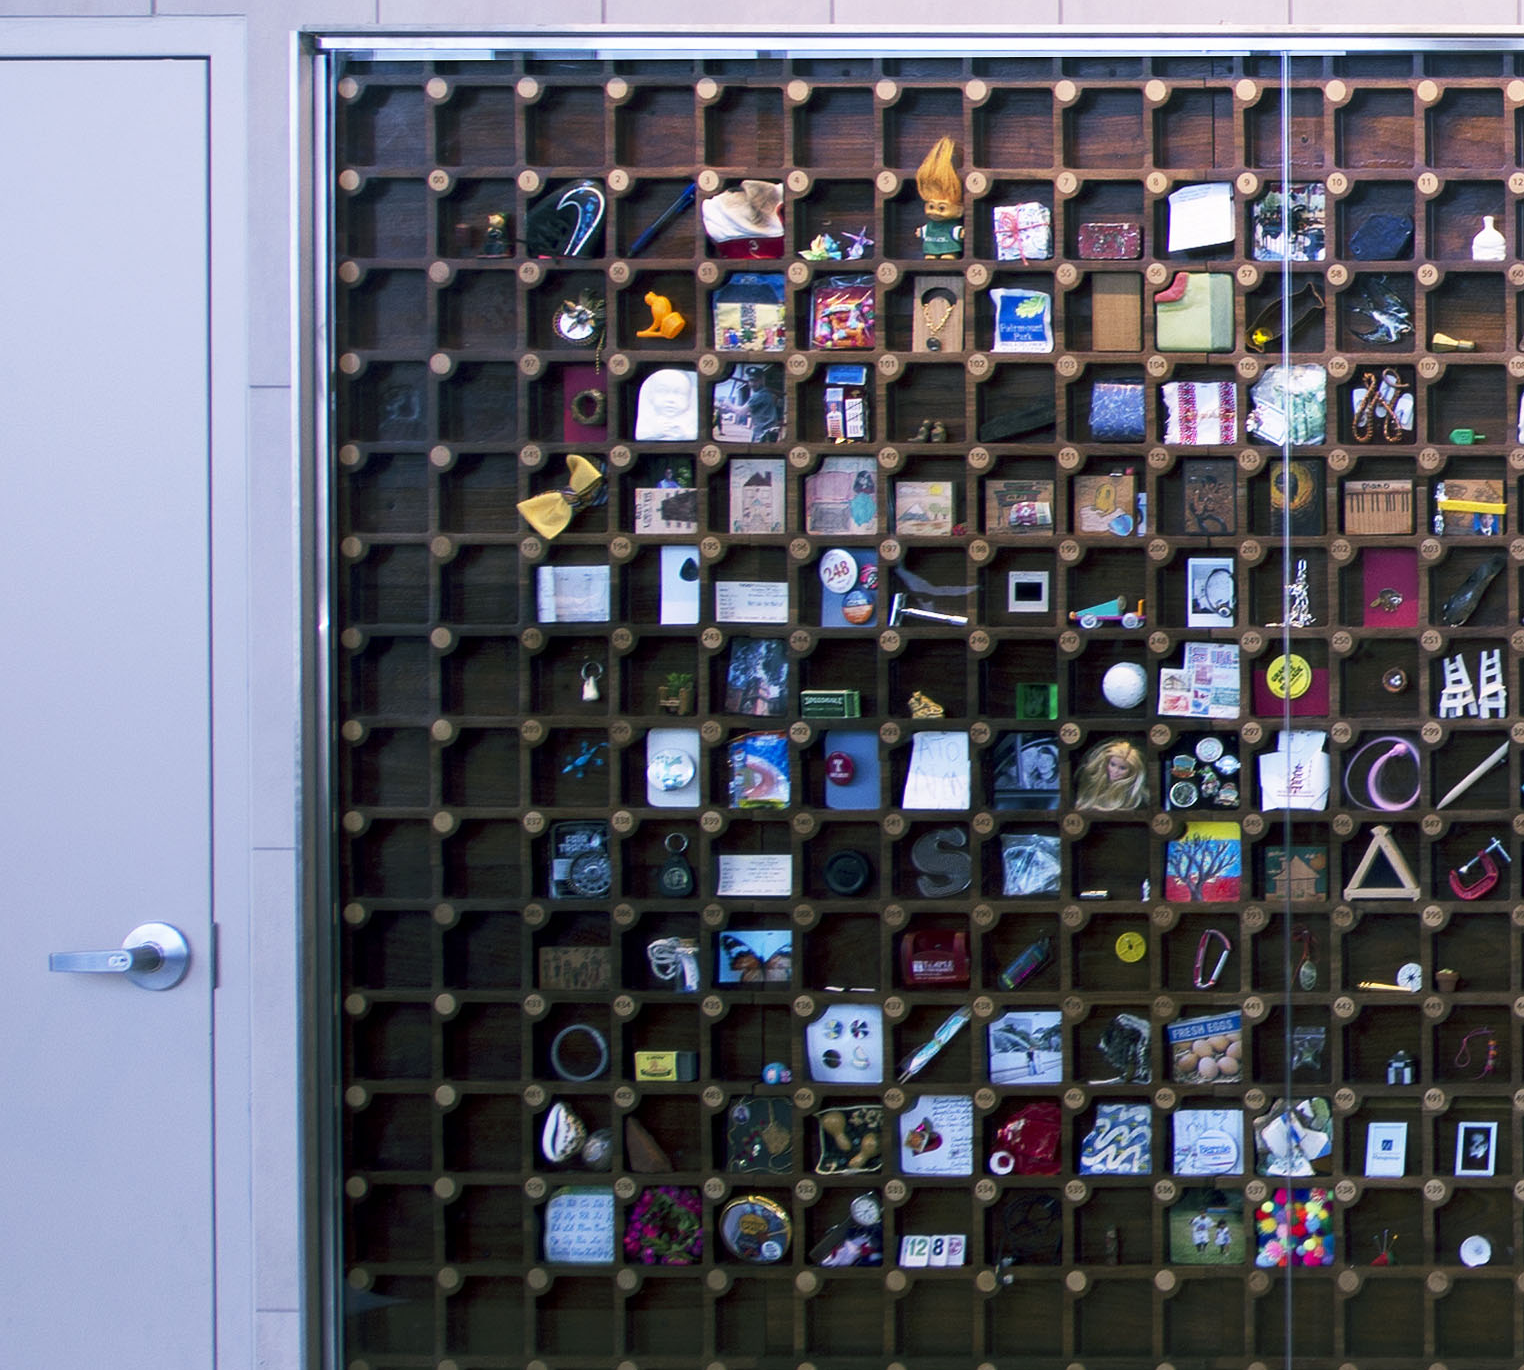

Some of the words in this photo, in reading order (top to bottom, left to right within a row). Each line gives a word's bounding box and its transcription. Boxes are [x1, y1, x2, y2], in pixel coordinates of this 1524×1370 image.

[615, 174, 621, 184] 2
[1421, 269, 1433, 279] 59
[1014, 332, 1032, 340] Park
[788, 360, 805, 368] 100
[1149, 360, 1165, 369] 104
[1331, 452, 1348, 463] 154
[823, 561, 850, 581] 248
[1171, 1026, 1205, 1039] FRESH
[1207, 1020, 1233, 1033] EGGS
[909, 1238, 927, 1256] 12
[934, 1238, 944, 1256] 8
